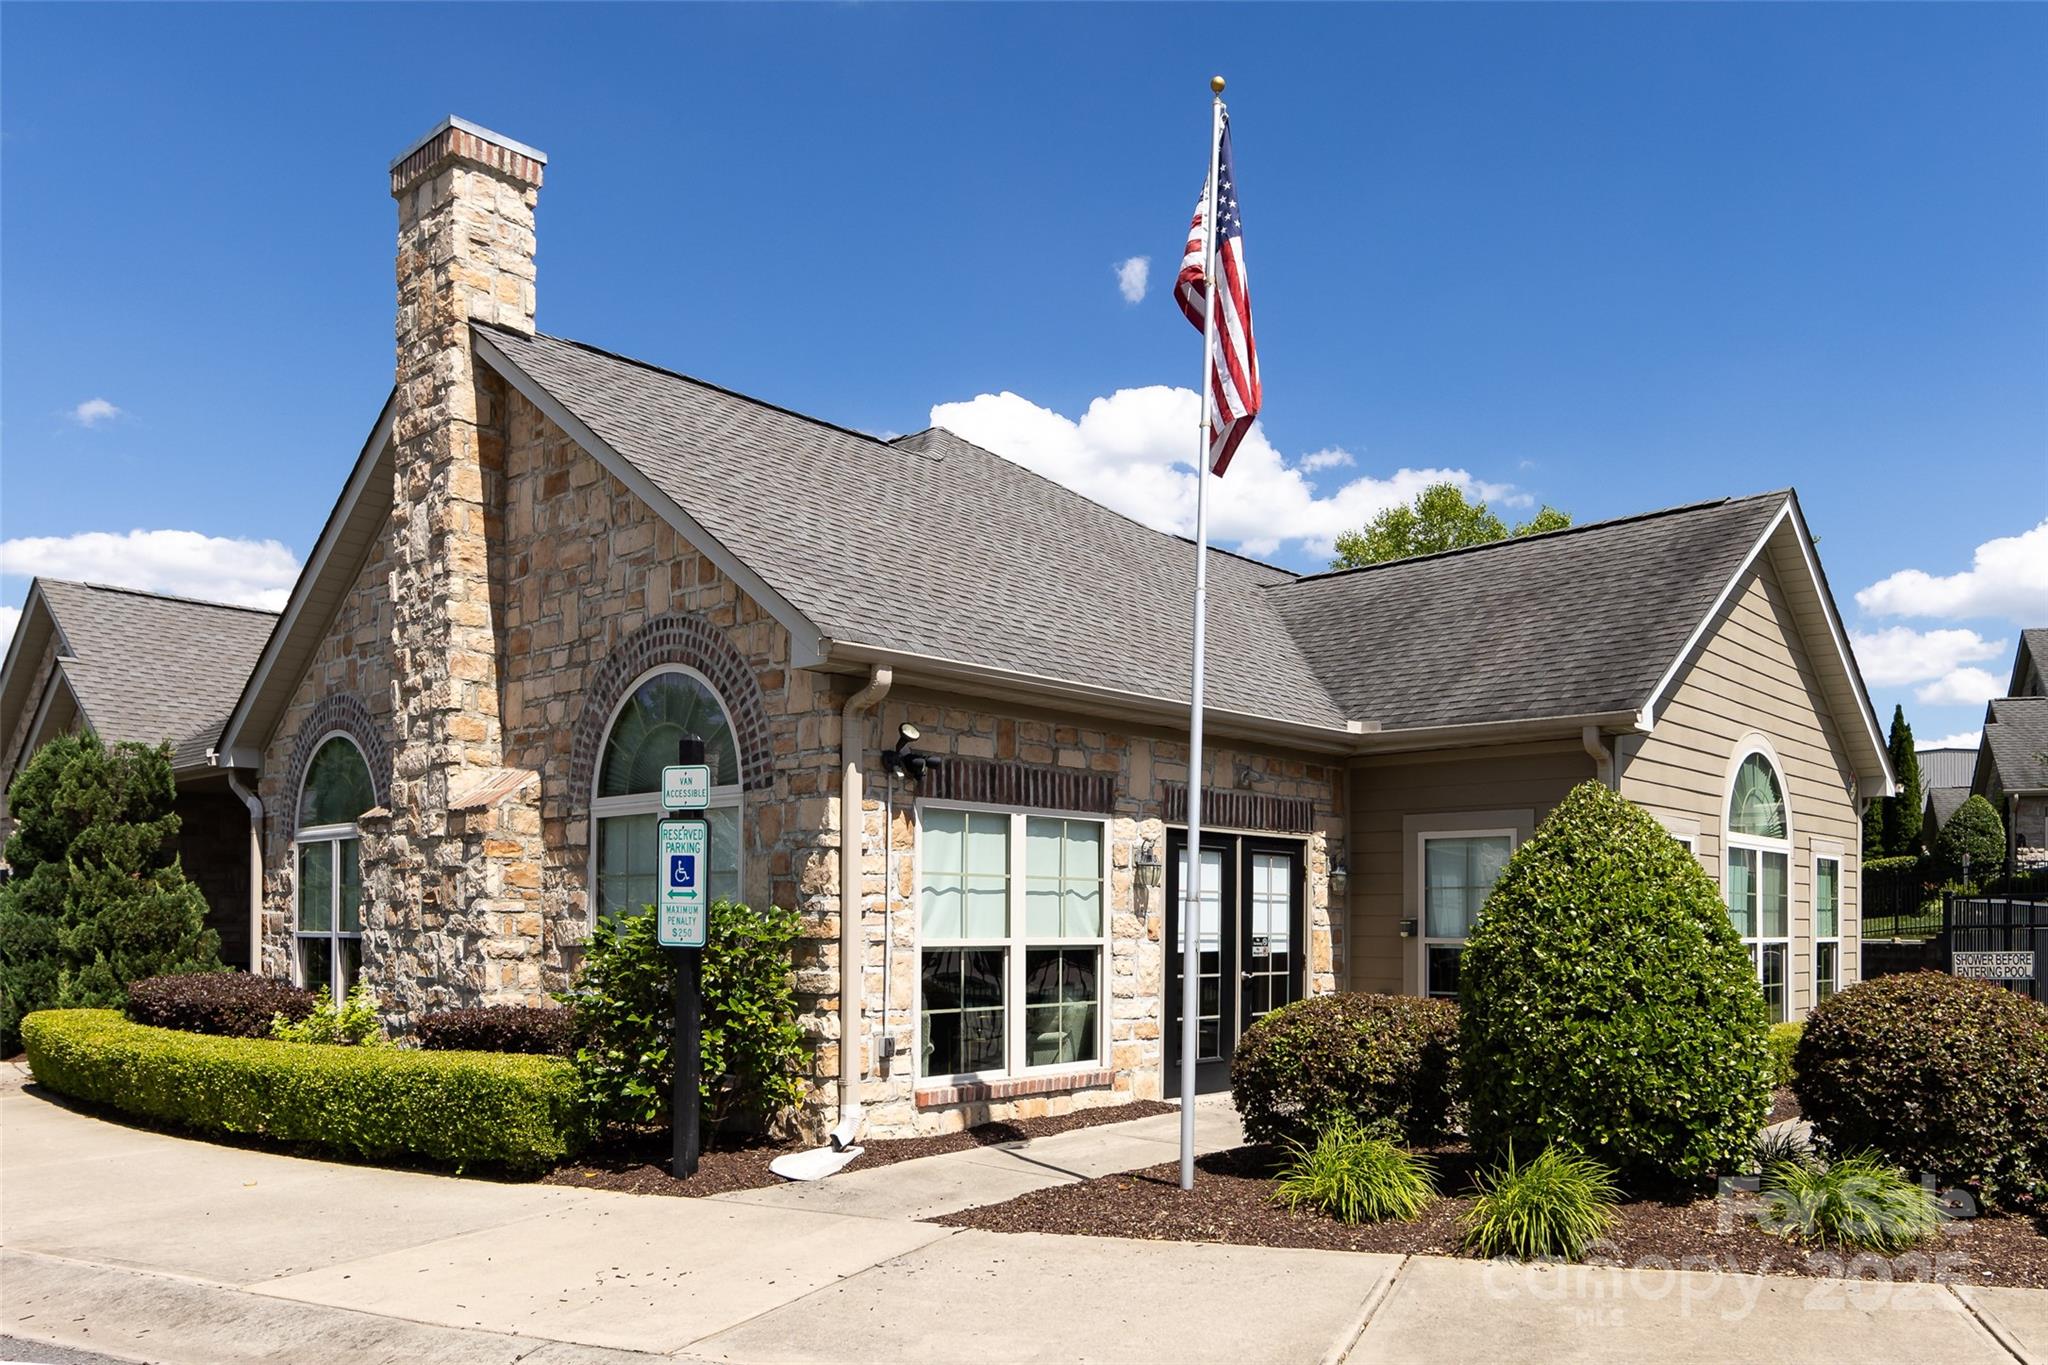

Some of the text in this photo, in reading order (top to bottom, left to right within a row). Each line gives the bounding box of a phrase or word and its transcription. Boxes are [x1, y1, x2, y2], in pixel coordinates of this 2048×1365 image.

[679, 777, 693, 786] VAN
[665, 788, 706, 798] ACCESSIBLE
[663, 829, 703, 840] RESERVED
[666, 842, 700, 853] PARKING
[666, 905, 698, 914] MAXIMUM
[667, 916, 696, 925] PENALTY
[672, 928, 692, 937] $250
[1955, 954, 2032, 965] SHOWER BEFORE
[1957, 966, 2032, 977] ENTERING POOL
